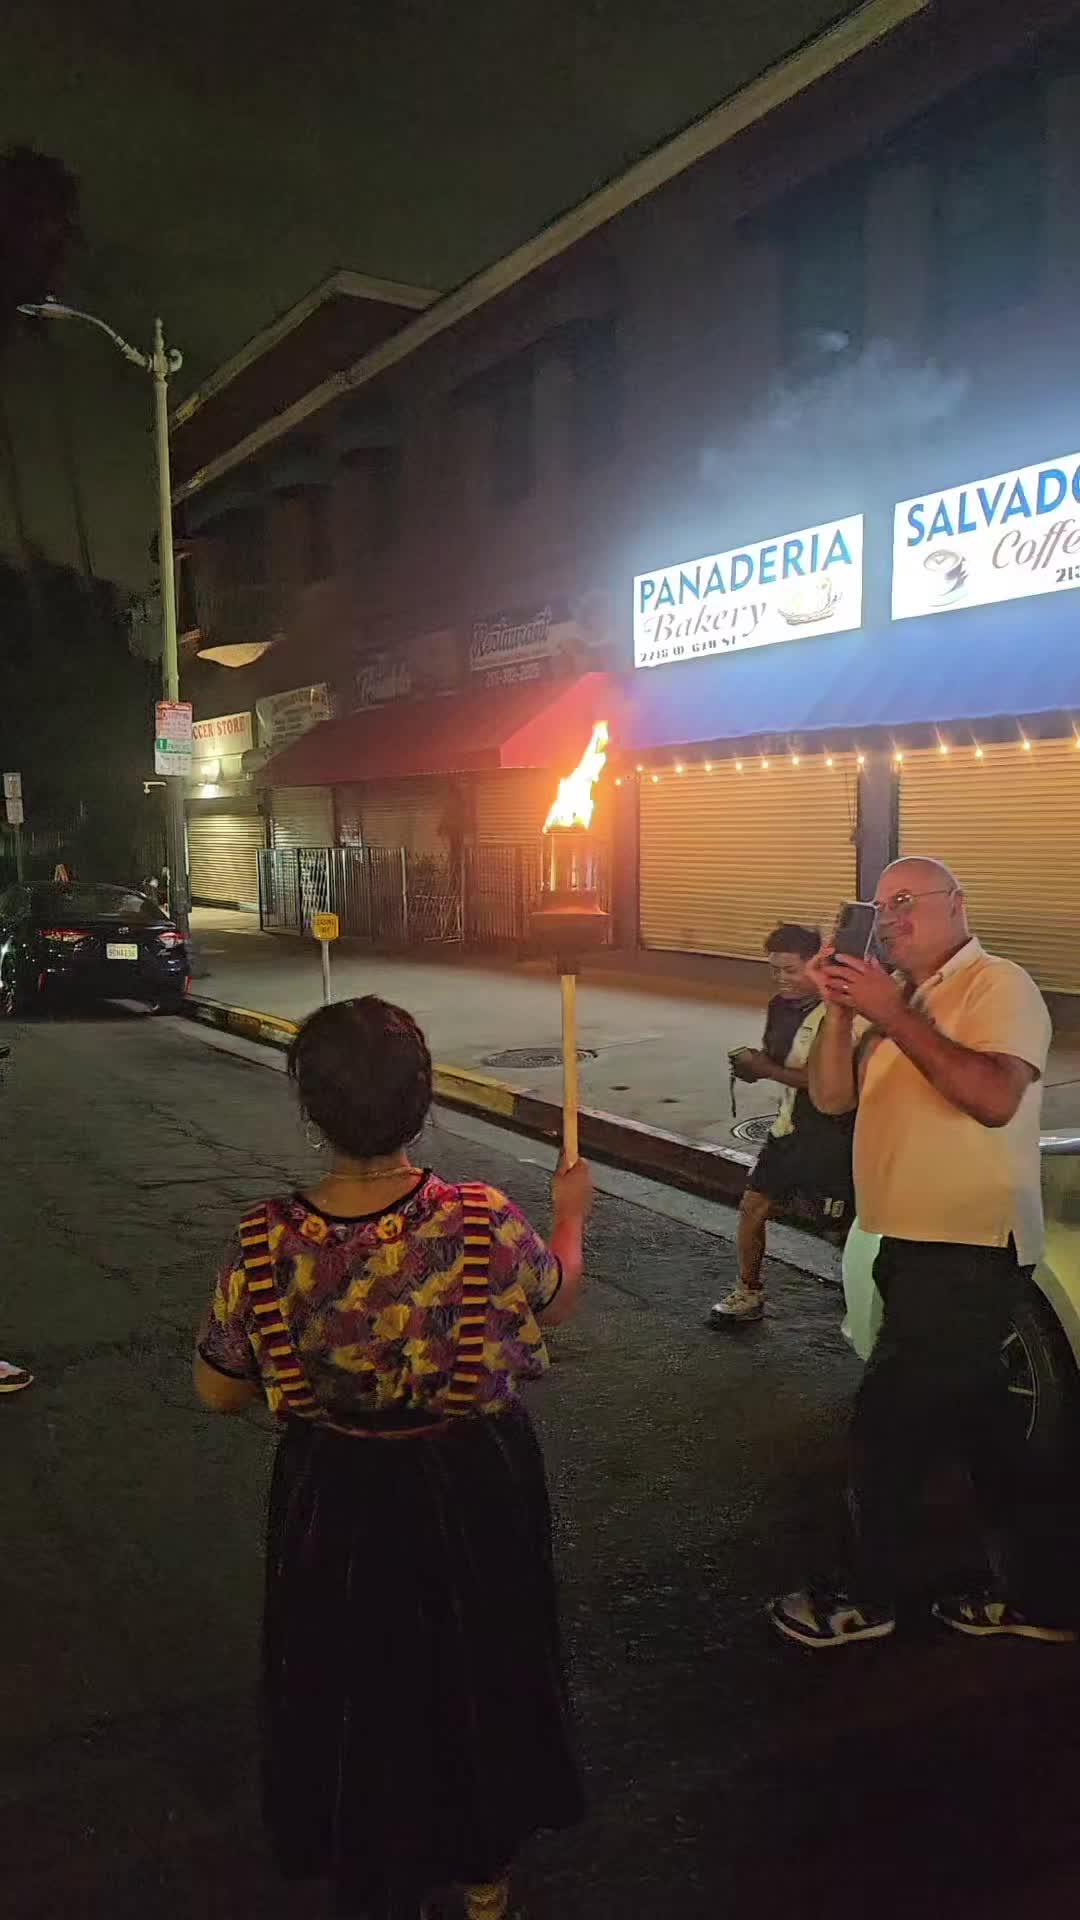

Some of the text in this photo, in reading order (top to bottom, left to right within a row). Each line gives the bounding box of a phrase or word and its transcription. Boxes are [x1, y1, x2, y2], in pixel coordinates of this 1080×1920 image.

[907, 464, 1080, 547] SALVAD
[640, 528, 852, 613] PANADERIA
[644, 602, 767, 642] Bakery
[216, 715, 246, 737] STORE
